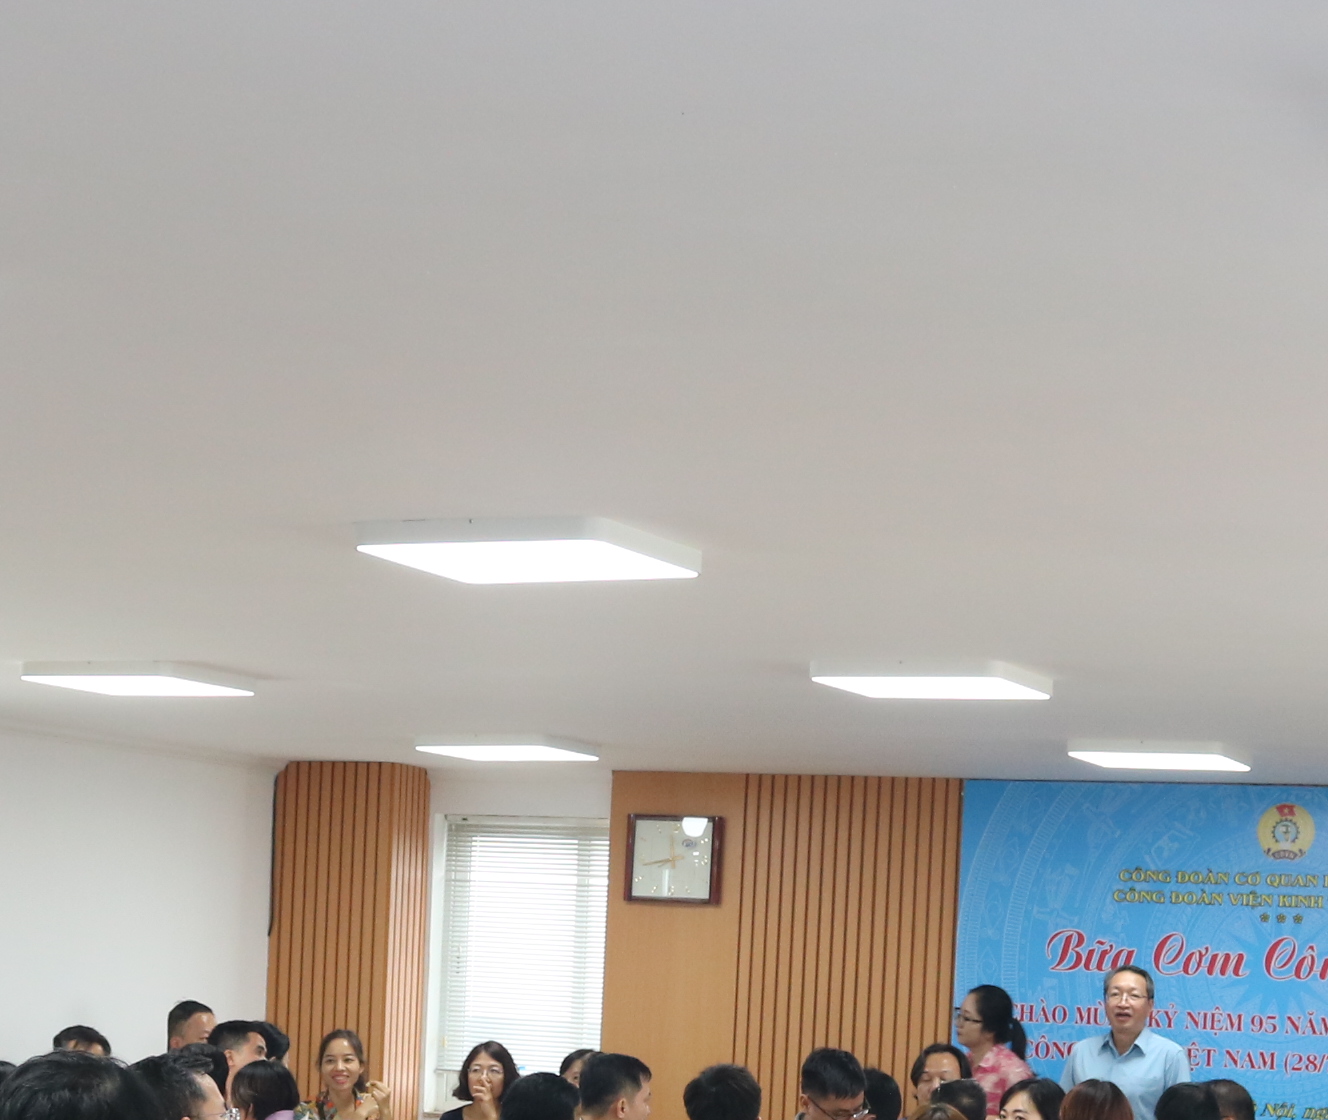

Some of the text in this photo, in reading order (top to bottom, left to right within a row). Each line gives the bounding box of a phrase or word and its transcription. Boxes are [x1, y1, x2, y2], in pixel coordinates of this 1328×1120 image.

[1119, 865, 1171, 883] CÔNG
[1176, 868, 1229, 885] ĐOÀN
[1234, 871, 1261, 886] CƠ
[1266, 873, 1319, 888] QUAN
[1113, 886, 1165, 904] CÔNG
[1170, 889, 1223, 905] ĐOÀN
[1228, 890, 1273, 909] VIỆN
[1278, 894, 1324, 908] KINH
[1046, 928, 1138, 972] Bữa
[1152, 931, 1250, 978] Cơm
[1147, 1003, 1179, 1028] KỶ
[1185, 1006, 1244, 1036] NIỆM
[1250, 1015, 1279, 1034] 95
[1187, 1041, 1217, 1071] ỆT
[1224, 1049, 1277, 1070] NAM
[1260, 1102, 1296, 1120] Nội,
